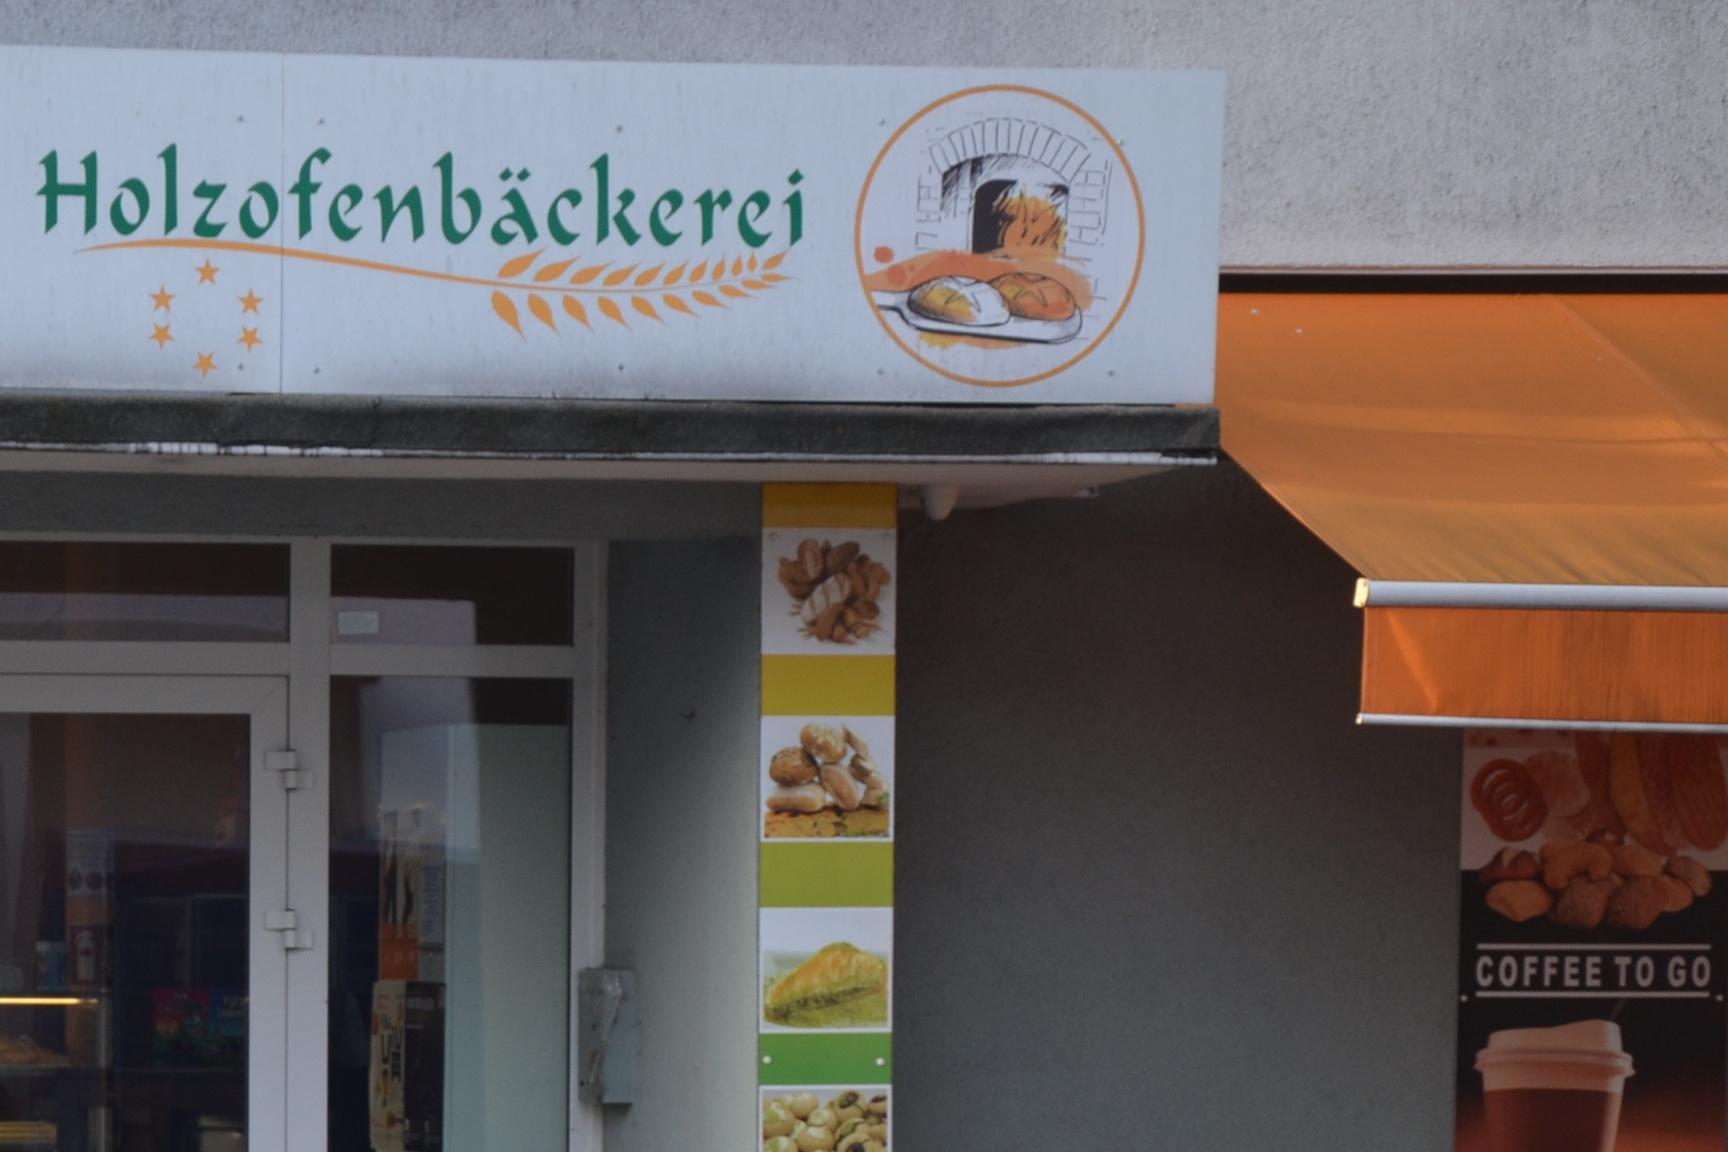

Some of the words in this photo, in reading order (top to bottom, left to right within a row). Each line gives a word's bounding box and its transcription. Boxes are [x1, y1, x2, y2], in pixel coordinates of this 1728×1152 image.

[37, 143, 807, 250] Holzofenbäckerei
[1475, 955, 1602, 987] COFFEE
[1614, 956, 1654, 987] TO
[1667, 956, 1711, 987] GO
